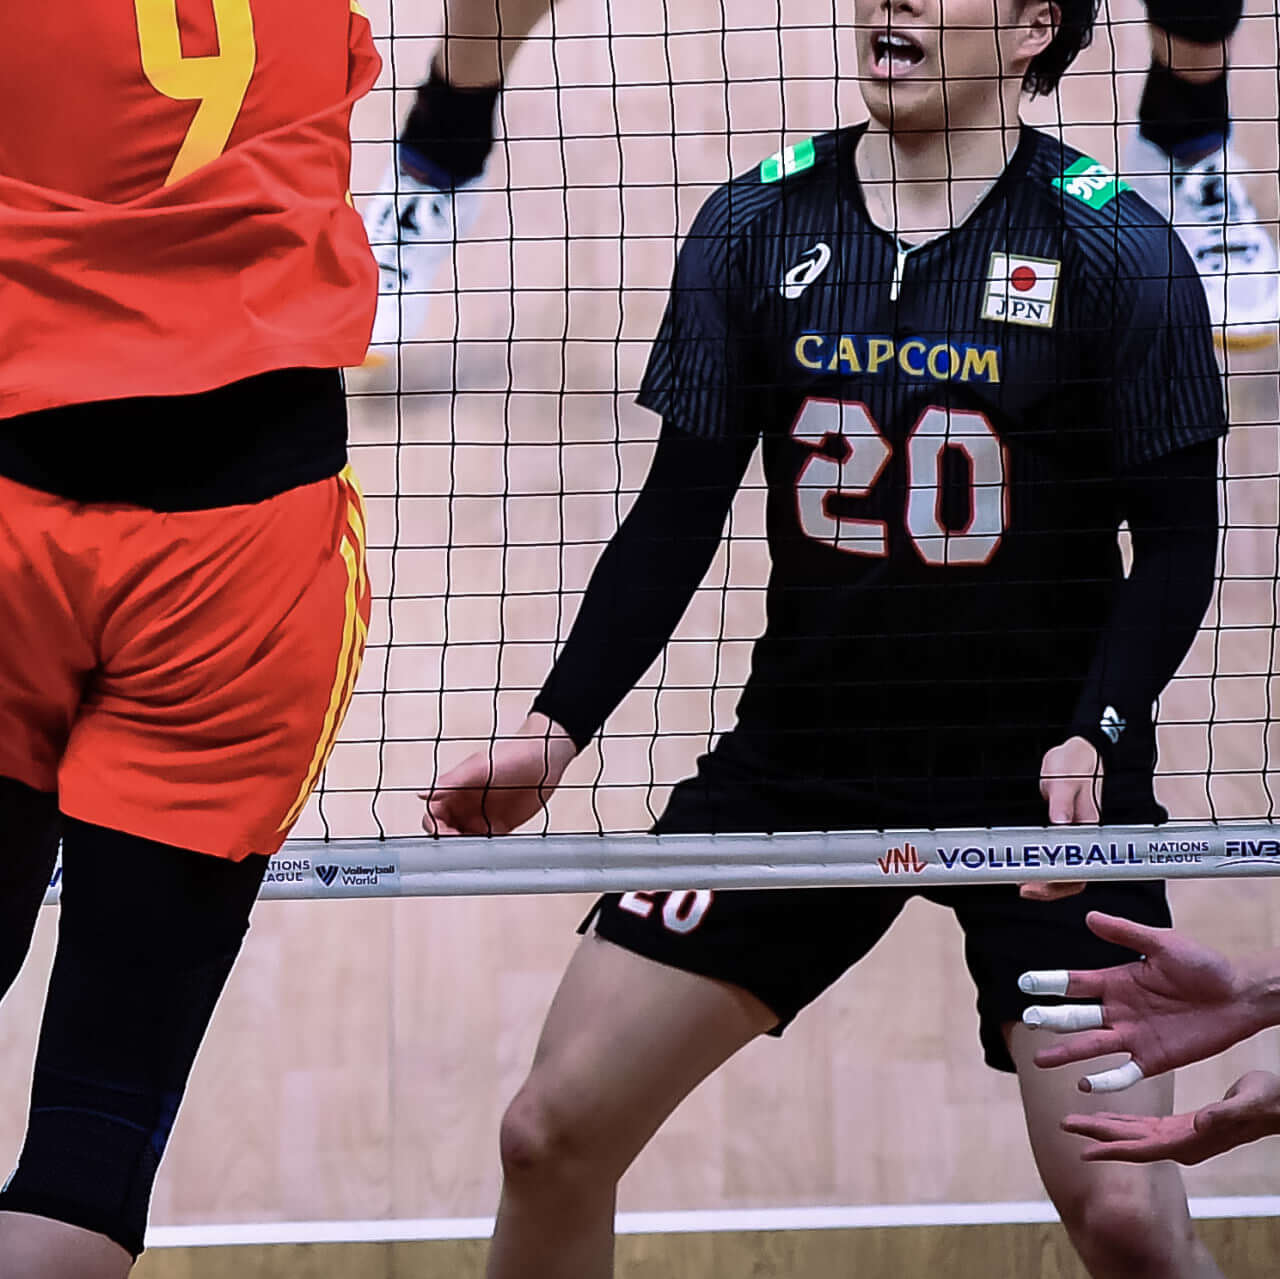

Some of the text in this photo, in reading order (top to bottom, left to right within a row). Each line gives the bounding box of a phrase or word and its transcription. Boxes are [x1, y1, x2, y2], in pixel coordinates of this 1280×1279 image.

[995, 299, 1045, 320] JPN
[794, 330, 1001, 383] CAPCOM
[789, 396, 1011, 565] 20
[1149, 841, 1209, 853] NATIONS
[937, 842, 1143, 869] VOLLEYBALL
[1149, 853, 1203, 864] LEAGUE
[267, 859, 310, 871] TIONS
[263, 872, 303, 882] AGUE
[342, 875, 378, 885] World
